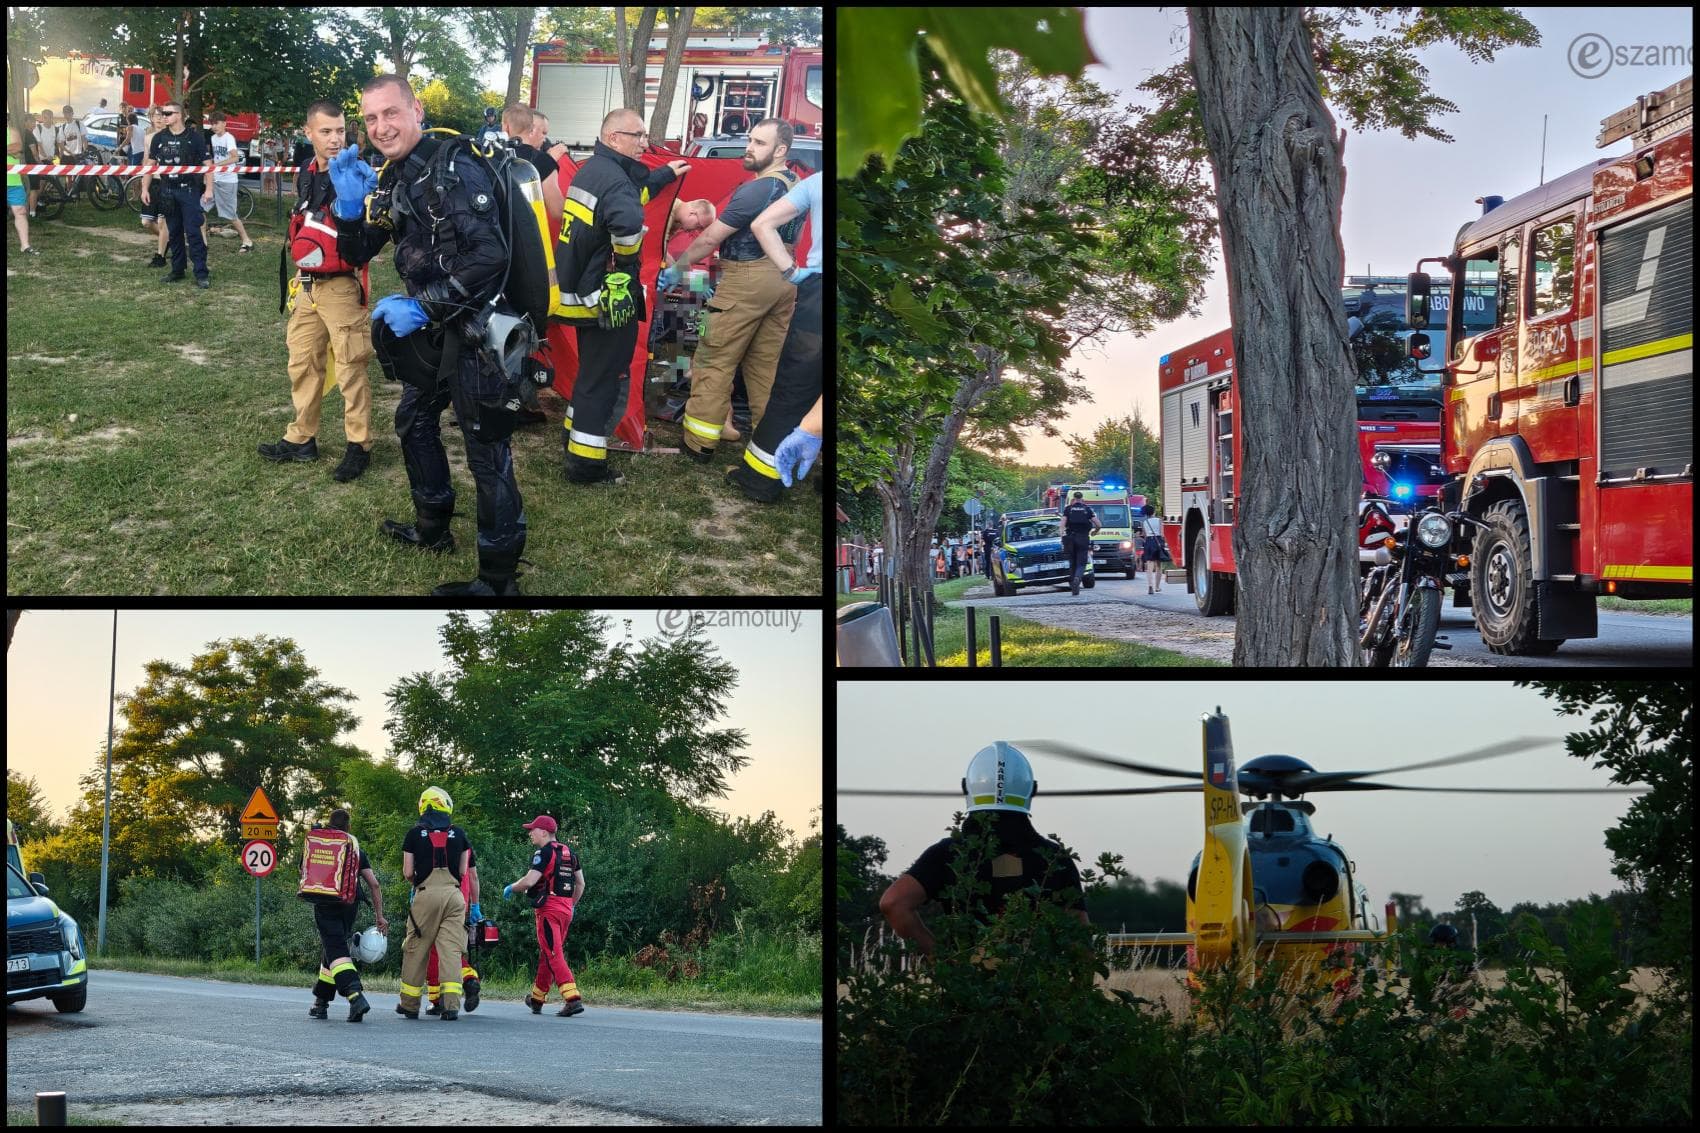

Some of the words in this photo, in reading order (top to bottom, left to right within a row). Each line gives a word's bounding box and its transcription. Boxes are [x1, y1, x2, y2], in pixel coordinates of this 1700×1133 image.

[997, 760, 1005, 804] MARCIN
[247, 827, 259, 836] 20
[249, 850, 271, 867] 20
